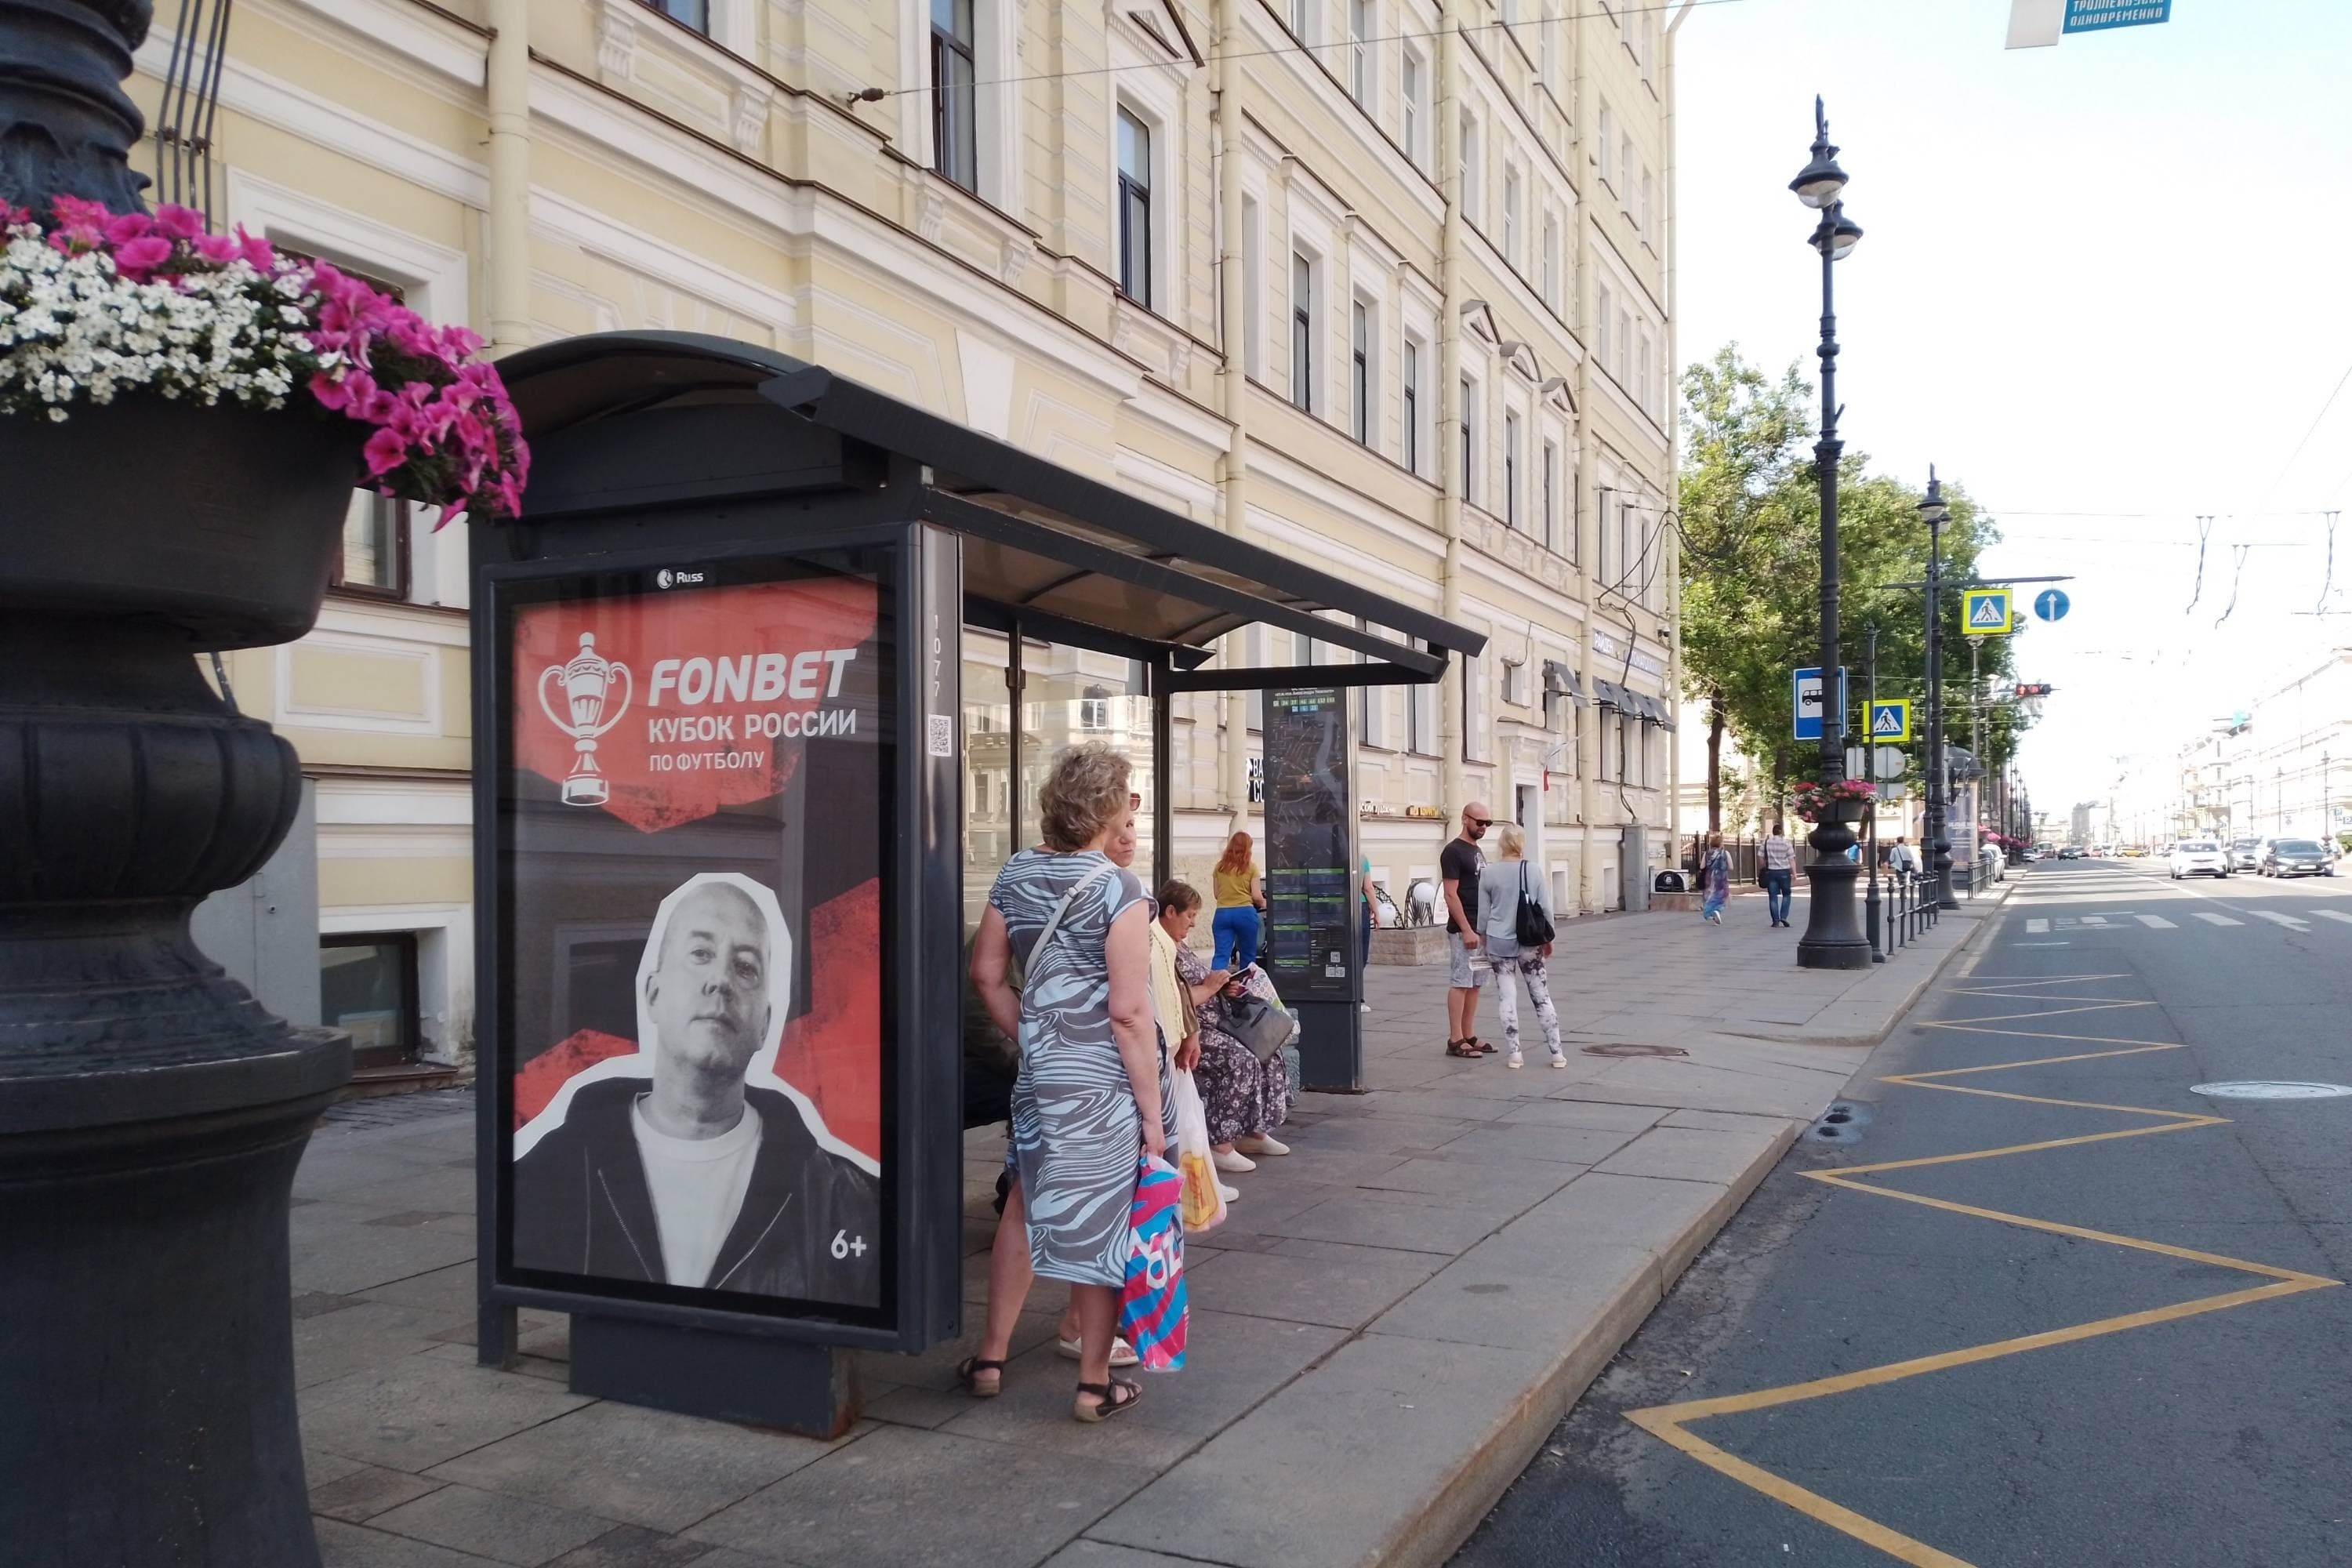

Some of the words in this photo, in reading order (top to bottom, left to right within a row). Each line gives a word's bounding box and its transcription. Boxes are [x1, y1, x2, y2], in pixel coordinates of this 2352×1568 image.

[2071, 7, 2163, 27] ОДНОВРЕМЕННО
[676, 572, 704, 584] Russ
[648, 648, 857, 706] FONBET
[648, 715, 733, 744] КУБОК
[745, 709, 857, 740] РОССИИ
[649, 753, 673, 772] ПО
[677, 750, 765, 772] ФУТБОЛУ
[830, 1229, 867, 1259] 6+
